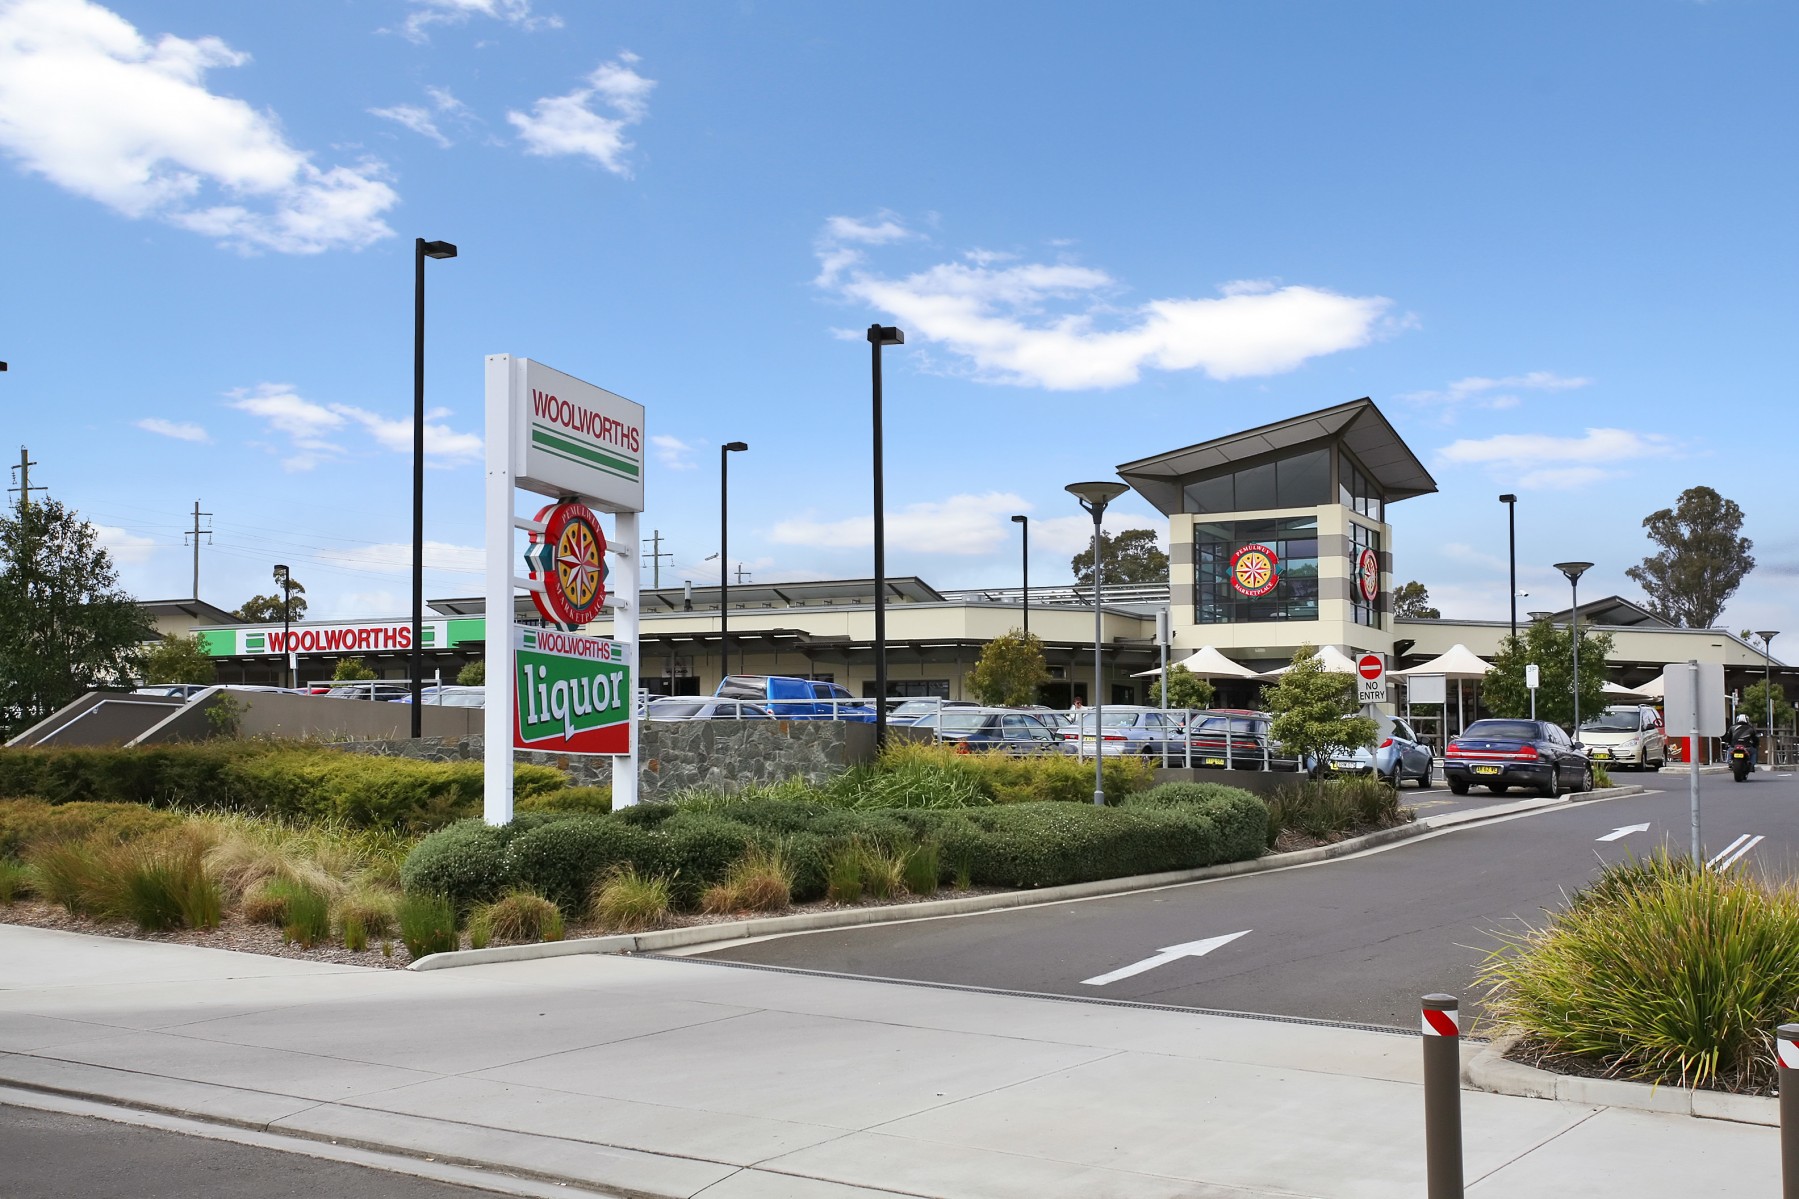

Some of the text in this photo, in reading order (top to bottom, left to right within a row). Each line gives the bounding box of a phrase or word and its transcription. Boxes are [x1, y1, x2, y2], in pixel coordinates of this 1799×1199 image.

[532, 388, 640, 453] WOOLWORTHS
[1235, 545, 1270, 557] PEMULWUY
[1235, 582, 1274, 596] MARKETPLACE
[556, 582, 605, 623] MARKETPLACE
[267, 626, 412, 652] WOOLWORTHS
[537, 631, 611, 660] WOOLWORTHS
[1359, 690, 1385, 701] ENTRY
[1365, 681, 1378, 690] NO
[523, 663, 623, 742] liquor
